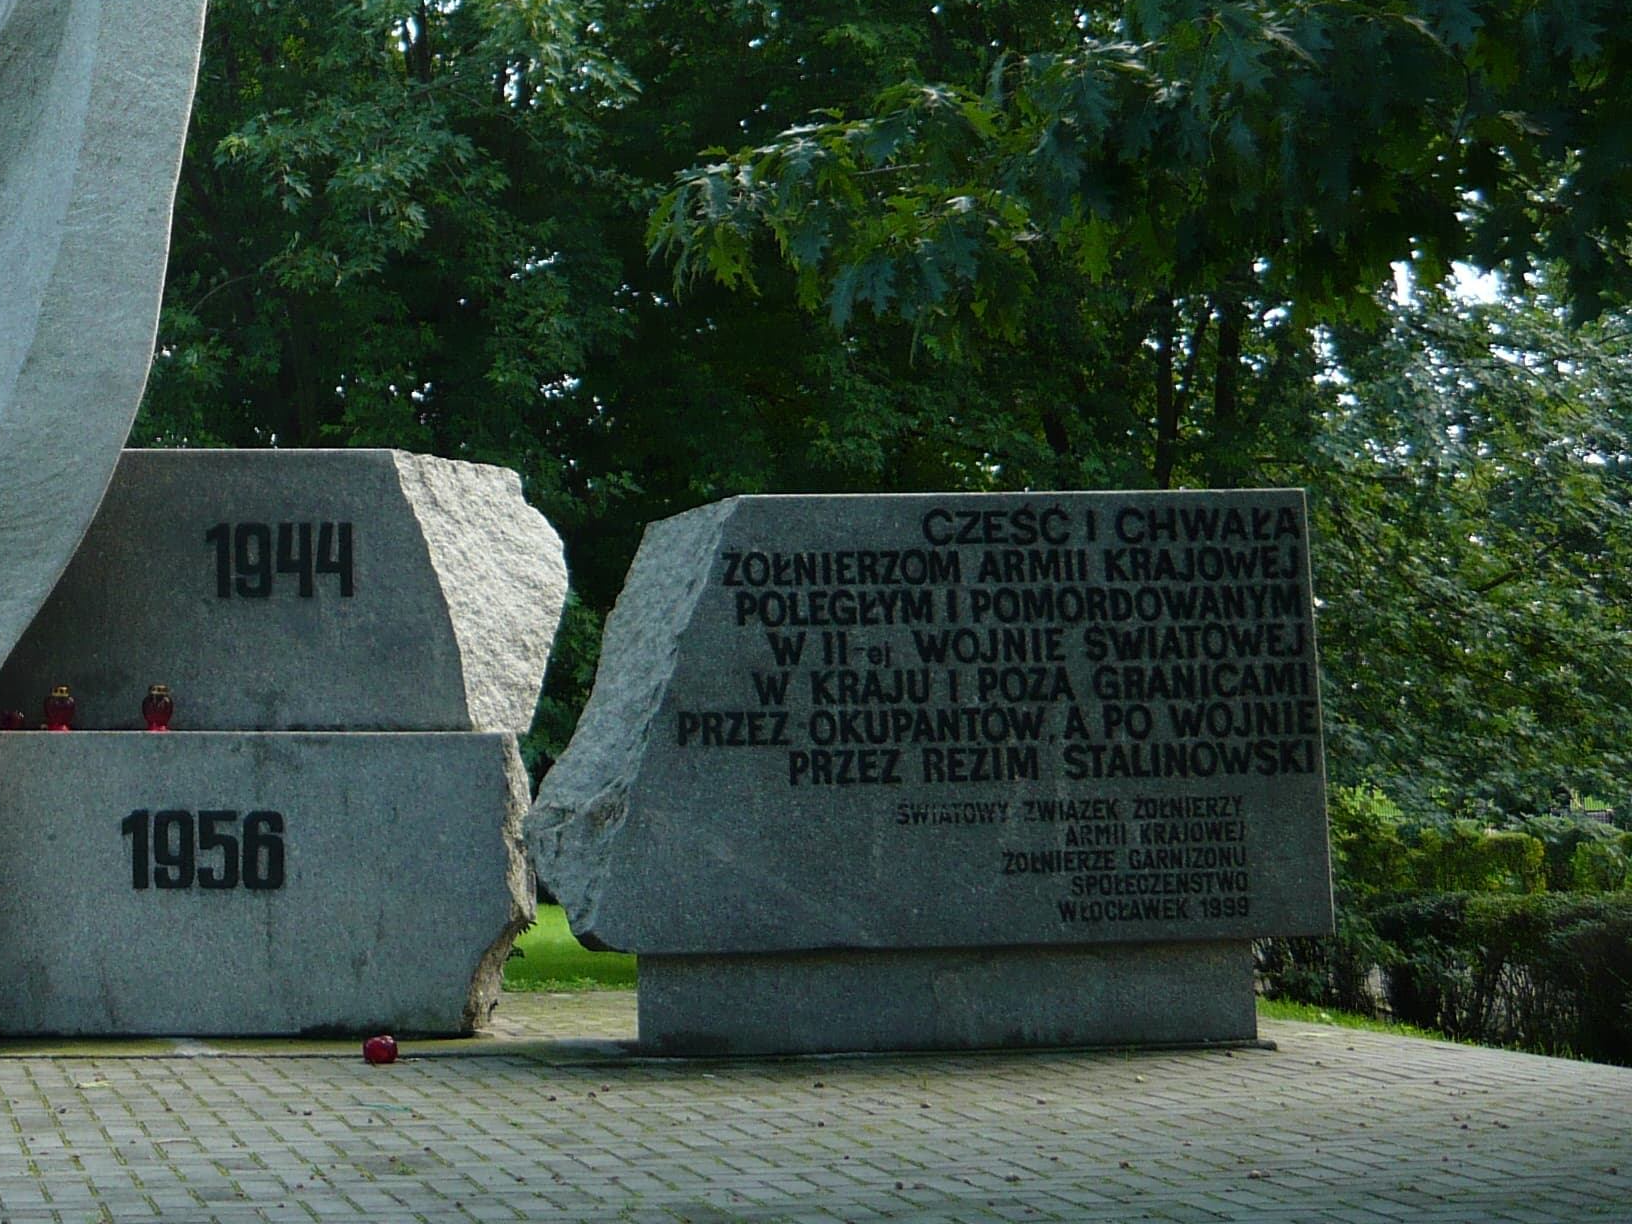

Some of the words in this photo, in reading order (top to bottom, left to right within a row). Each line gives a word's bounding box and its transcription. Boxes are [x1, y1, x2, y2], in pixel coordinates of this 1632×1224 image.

[921, 503, 1070, 546] CZEŚĆ
[1086, 509, 1097, 542] I
[1116, 506, 1300, 544] CHWAŁA
[205, 521, 354, 598] 1944
[721, 545, 962, 587] ŻOŁNIERZOM
[978, 548, 1088, 584] ARMII
[1103, 544, 1300, 583] KRAJOWEJ
[734, 588, 934, 627] POLEGŁYM
[947, 588, 958, 624] I
[971, 584, 1303, 624] POMORDOWANYM
[767, 630, 806, 667] W
[911, 627, 1067, 664] WOJNIE
[751, 670, 790, 706] W
[810, 669, 931, 705] KRAJU
[948, 669, 959, 702] I
[977, 665, 1076, 703] POZA
[1092, 662, 1310, 701] GRANICAMI
[677, 710, 793, 747] PRZEZ
[1063, 705, 1090, 741] A
[1103, 703, 1153, 741] PO
[1168, 699, 1319, 738] WOJNIE
[788, 748, 903, 786] PRZEZ
[921, 740, 1040, 783] REŻIM
[1063, 738, 1316, 780] STALINOWSKI
[120, 808, 286, 891] 1956
[1065, 823, 1128, 847] ARMII
[1139, 820, 1246, 845] KRAJOWEJ
[1127, 845, 1248, 871] GARNIZONU
[1058, 897, 1191, 923] WŁOCŁAWEK
[1199, 895, 1251, 919] 1999
